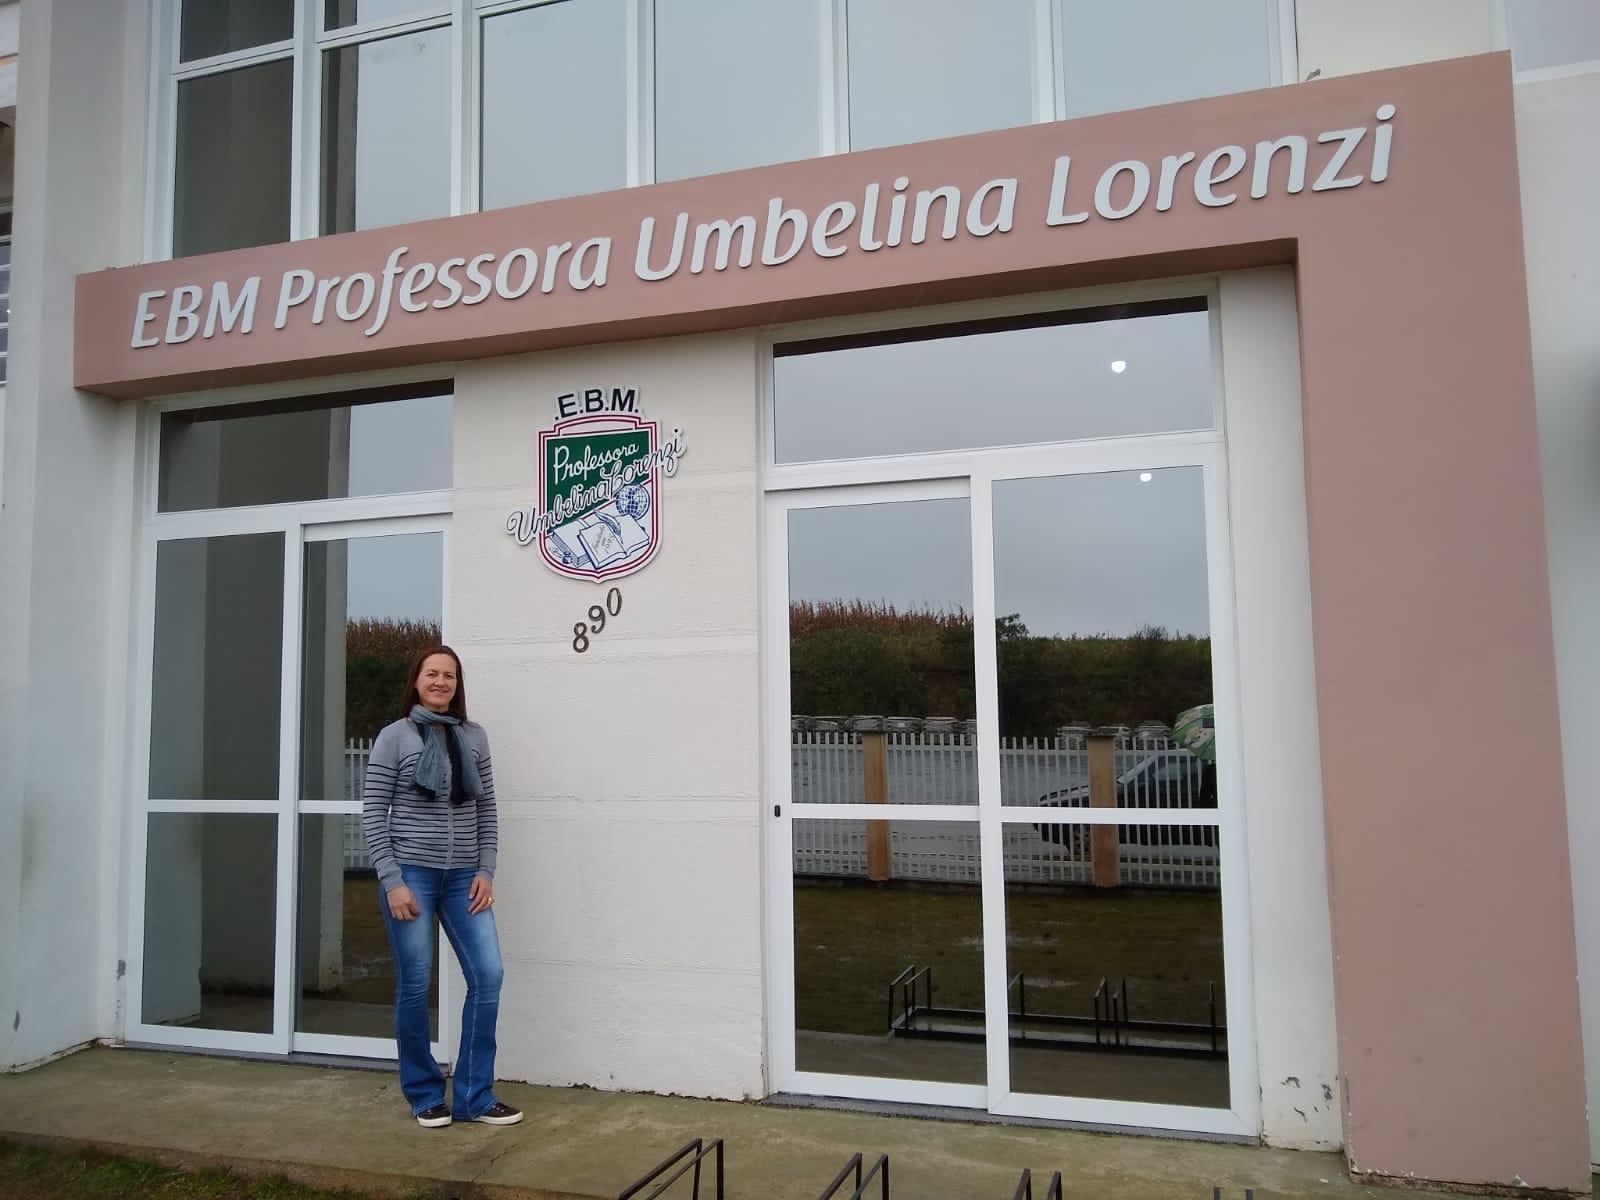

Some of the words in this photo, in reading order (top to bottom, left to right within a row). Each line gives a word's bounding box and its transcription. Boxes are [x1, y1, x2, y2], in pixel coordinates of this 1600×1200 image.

[131, 276, 261, 349] EBM
[274, 236, 612, 336] Professora
[634, 175, 1018, 282] Umbelina
[1045, 104, 1397, 227] Lorenzi
[507, 480, 612, 545] Umbelina
[600, 428, 684, 498] Lorenzi
[553, 443, 640, 486] Professora
[572, 587, 623, 653] 890
